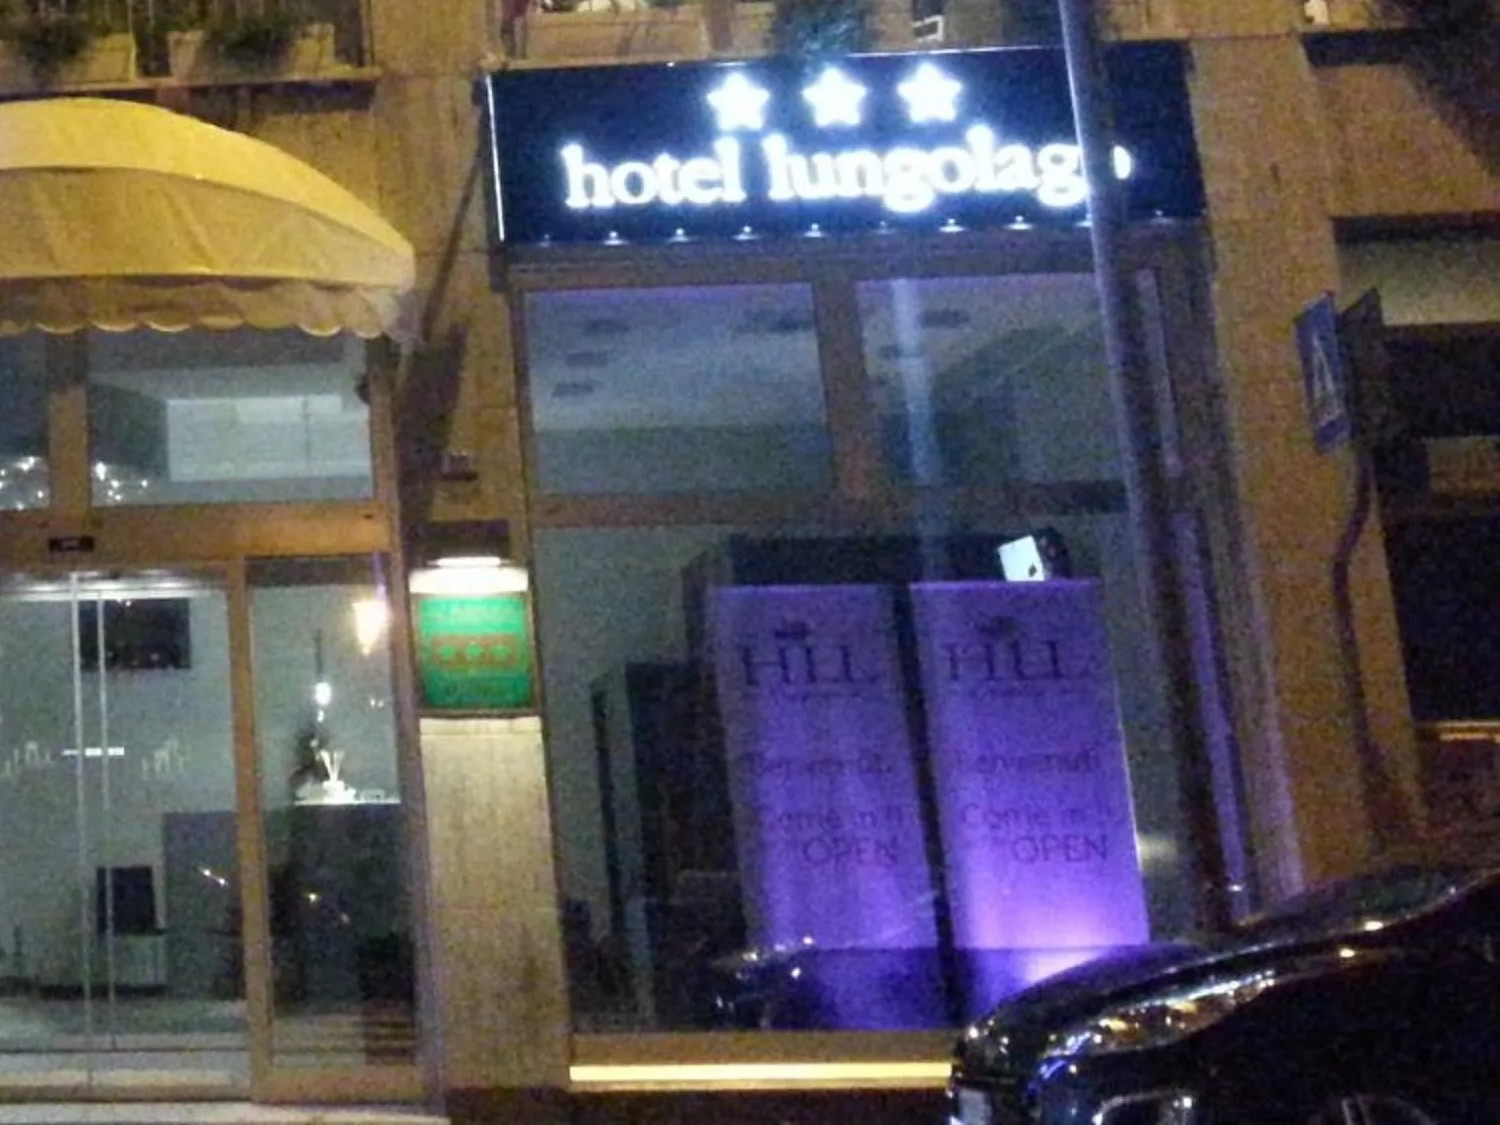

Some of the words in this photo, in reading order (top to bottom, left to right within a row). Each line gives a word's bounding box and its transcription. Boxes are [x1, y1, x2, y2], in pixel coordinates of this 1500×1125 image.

[560, 135, 748, 210] hotel
[761, 125, 1133, 214] lungolag
[802, 835, 899, 865] OPEN
[1010, 832, 1108, 863] OPEN
